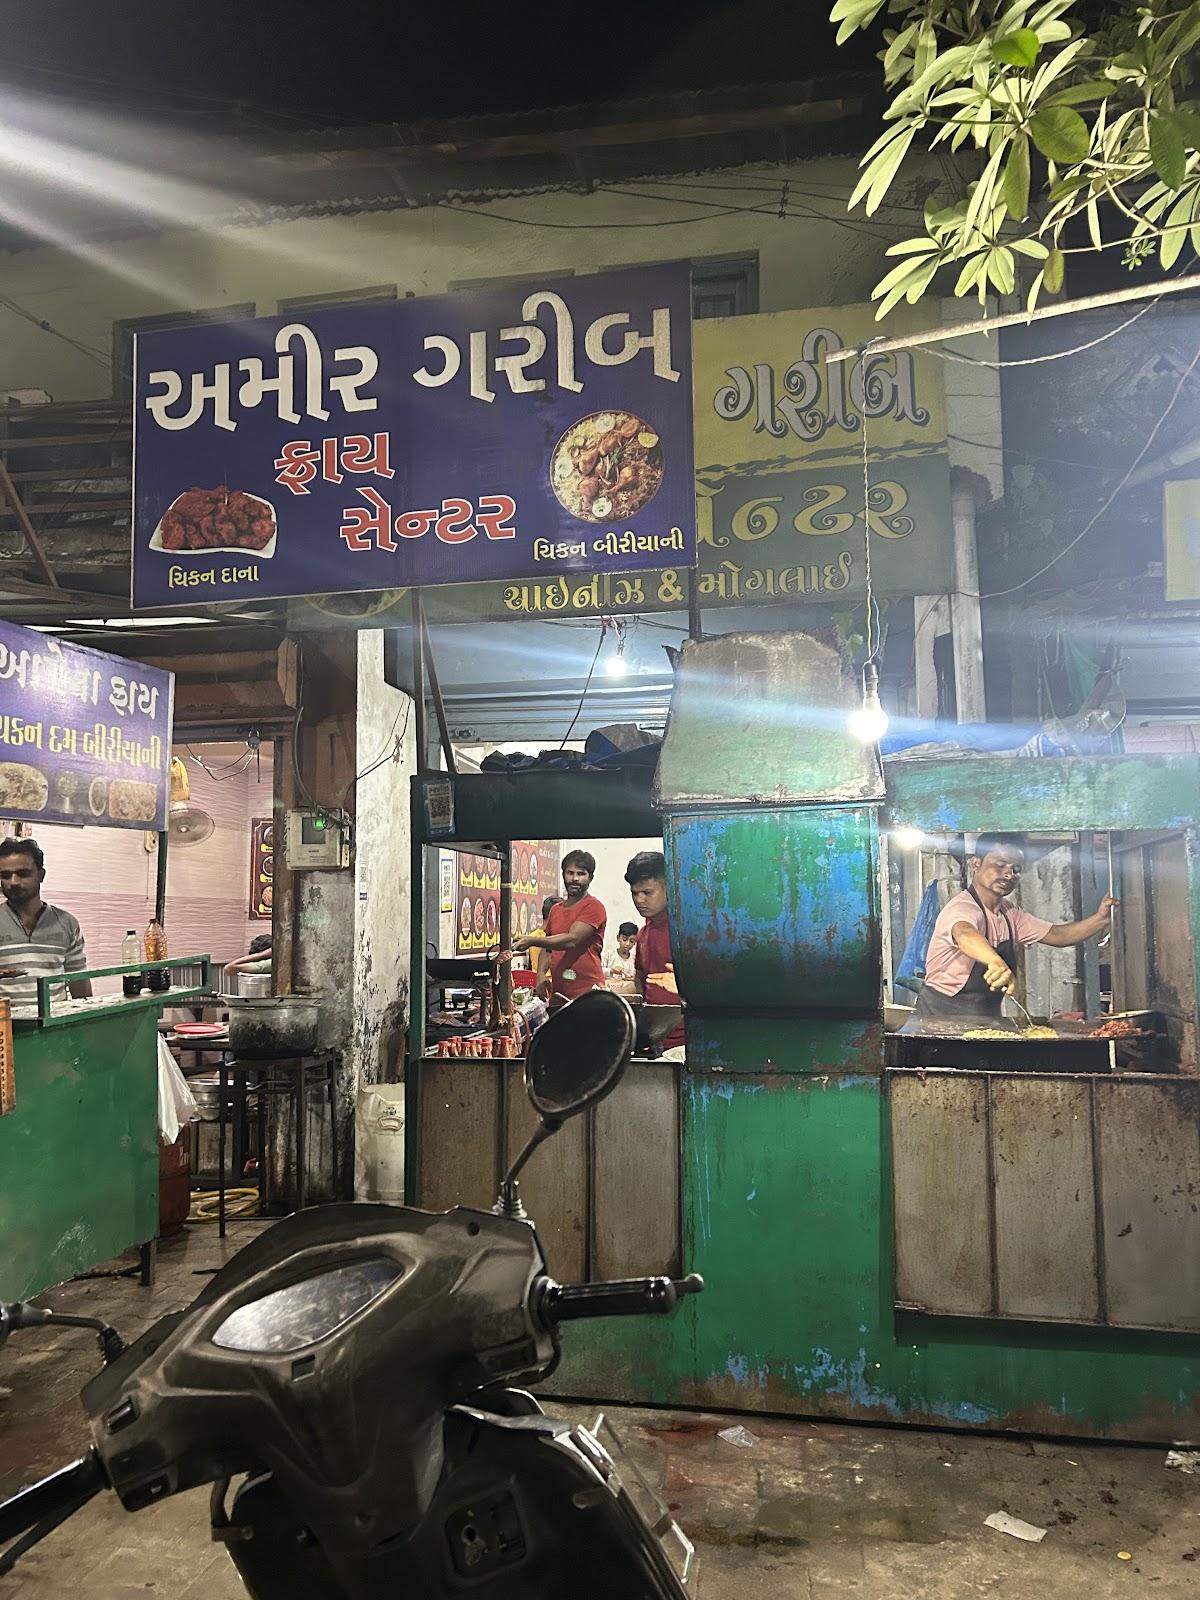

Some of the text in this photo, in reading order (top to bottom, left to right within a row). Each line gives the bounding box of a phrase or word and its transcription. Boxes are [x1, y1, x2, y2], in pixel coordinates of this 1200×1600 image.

[144, 290, 681, 432] અમીર ગરીબ
[713, 328, 930, 442] ગરીબ
[273, 431, 396, 496] ફ્રાય
[339, 486, 517, 553] સેન્ટર
[533, 526, 685, 561] ચિકન બીરીયાની
[168, 565, 260, 589] ચિકન દાના
[657, 569, 685, 603] &
[49, 725, 78, 756] દમ
[83, 722, 161, 769] બીરીયાની
